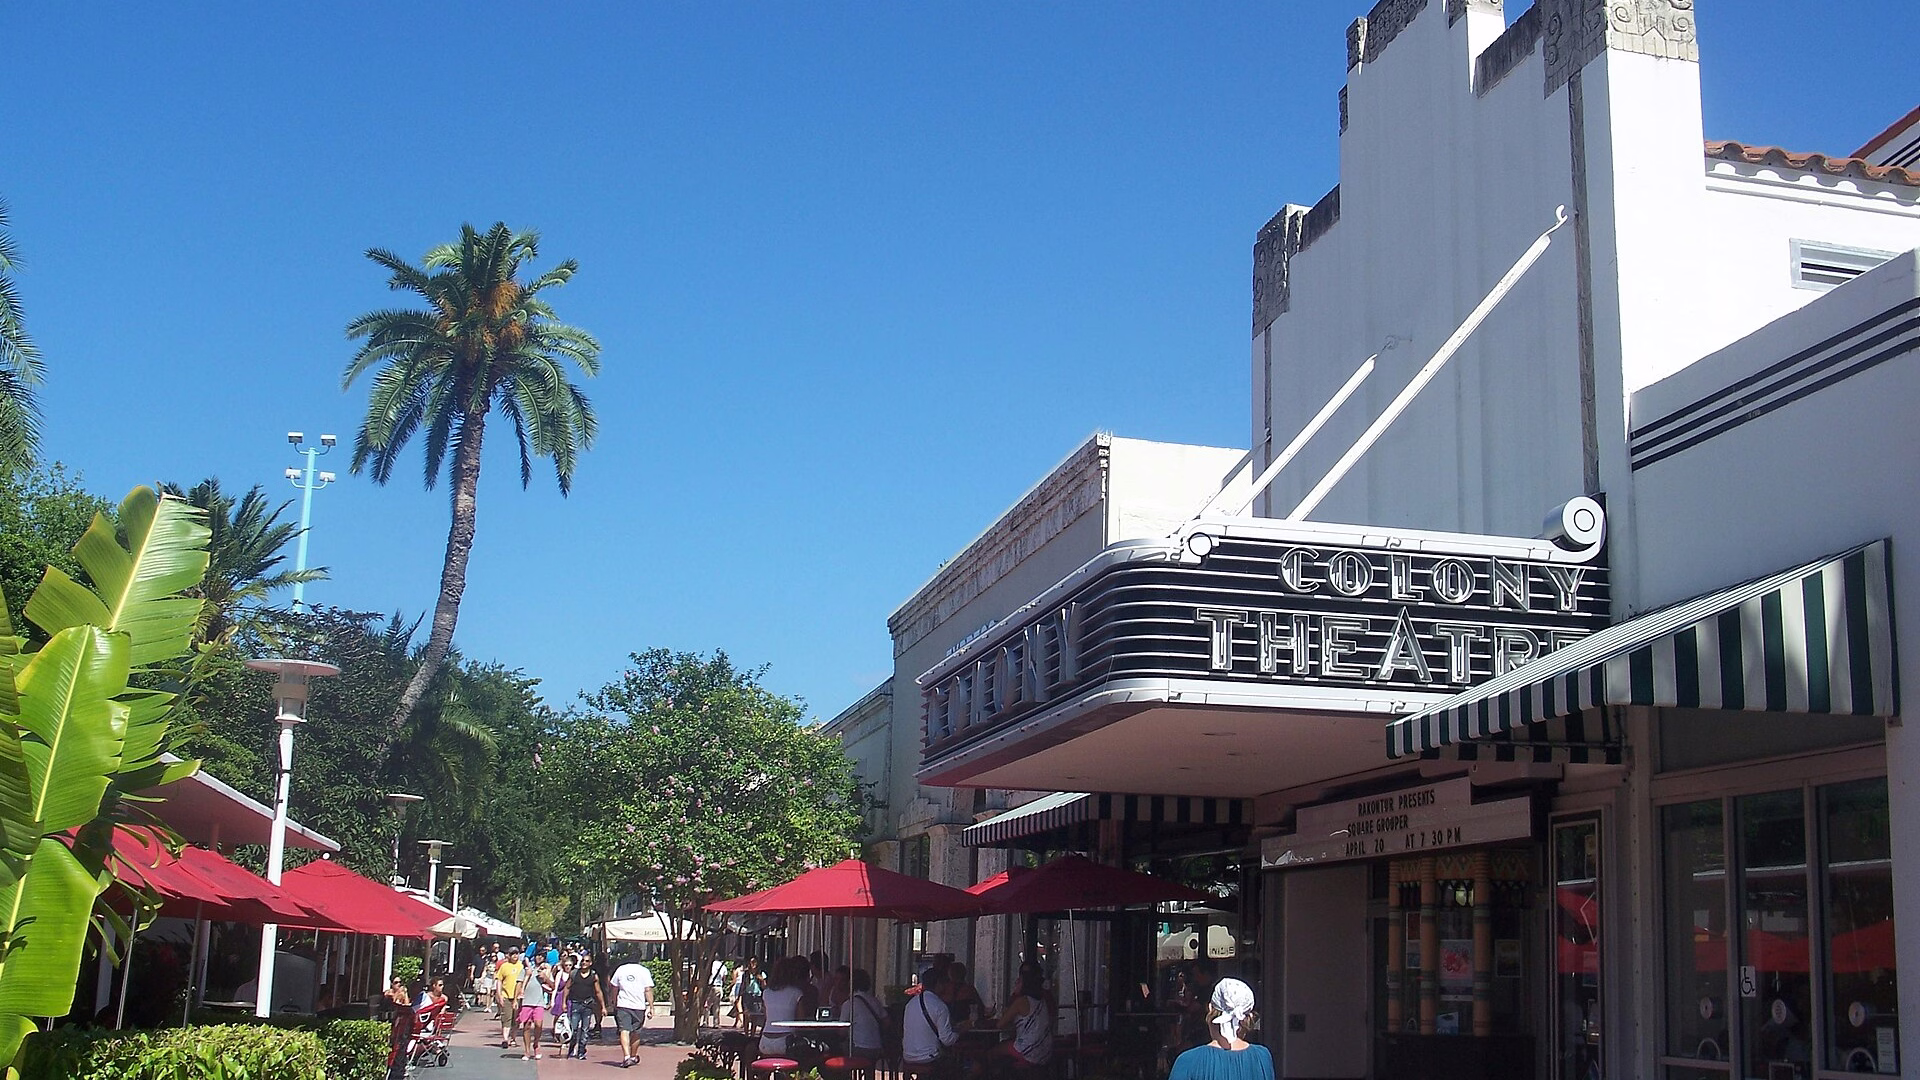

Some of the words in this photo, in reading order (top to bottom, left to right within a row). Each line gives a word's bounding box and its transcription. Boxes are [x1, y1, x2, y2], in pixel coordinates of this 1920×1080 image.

[1280, 546, 1588, 613] COLONY
[1358, 797, 1394, 817] RAKONTUR
[1398, 789, 1435, 810] PRESENTS
[1347, 819, 1374, 838] SQUARE
[1376, 814, 1409, 834] GROUPER
[1345, 840, 1366, 857] APRIL
[1374, 838, 1385, 853] 20
[1405, 833, 1415, 849] AT
[1420, 832, 1425, 847] 7
[1431, 830, 1443, 846] 30
